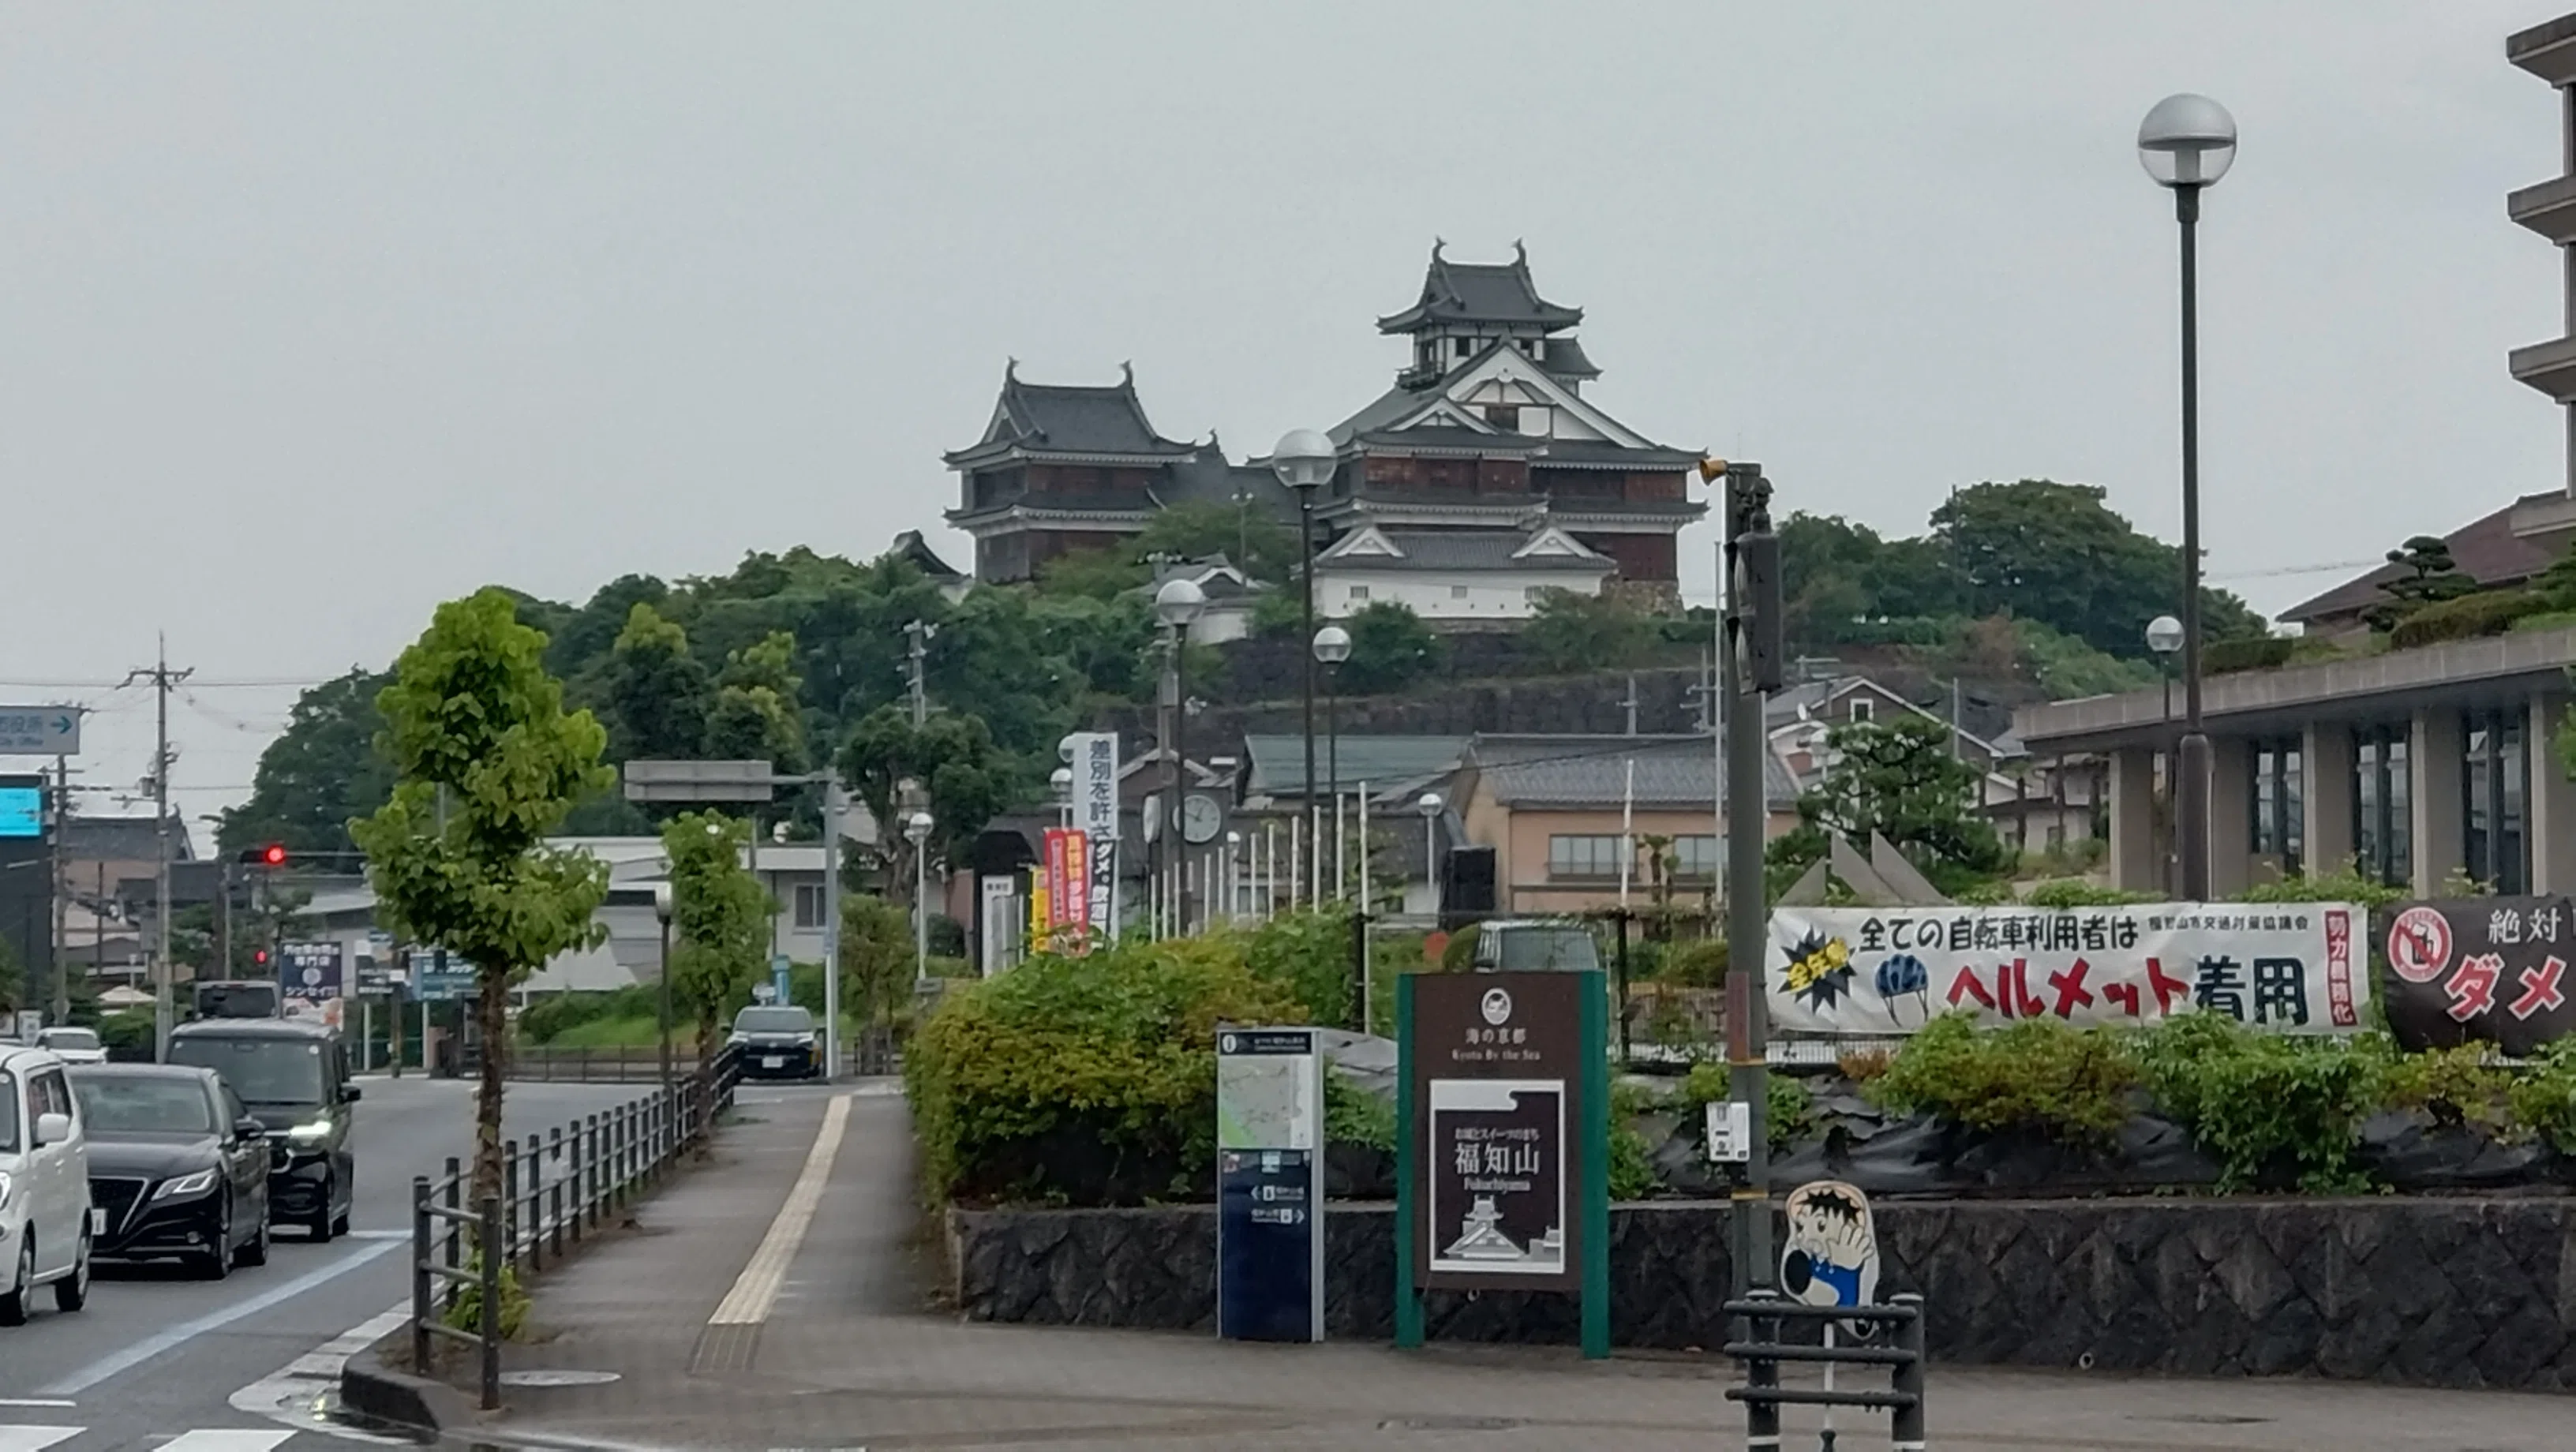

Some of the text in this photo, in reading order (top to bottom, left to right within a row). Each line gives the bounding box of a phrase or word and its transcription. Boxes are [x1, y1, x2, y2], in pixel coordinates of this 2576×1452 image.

[1859, 914, 2140, 952] 全ての自転車利用者は
[2488, 908, 2576, 945] 絶対
[1945, 954, 2310, 1026] ヘルメット着用
[2443, 952, 2567, 1024] ダメ
[1455, 1143, 1540, 1174] 福知山
